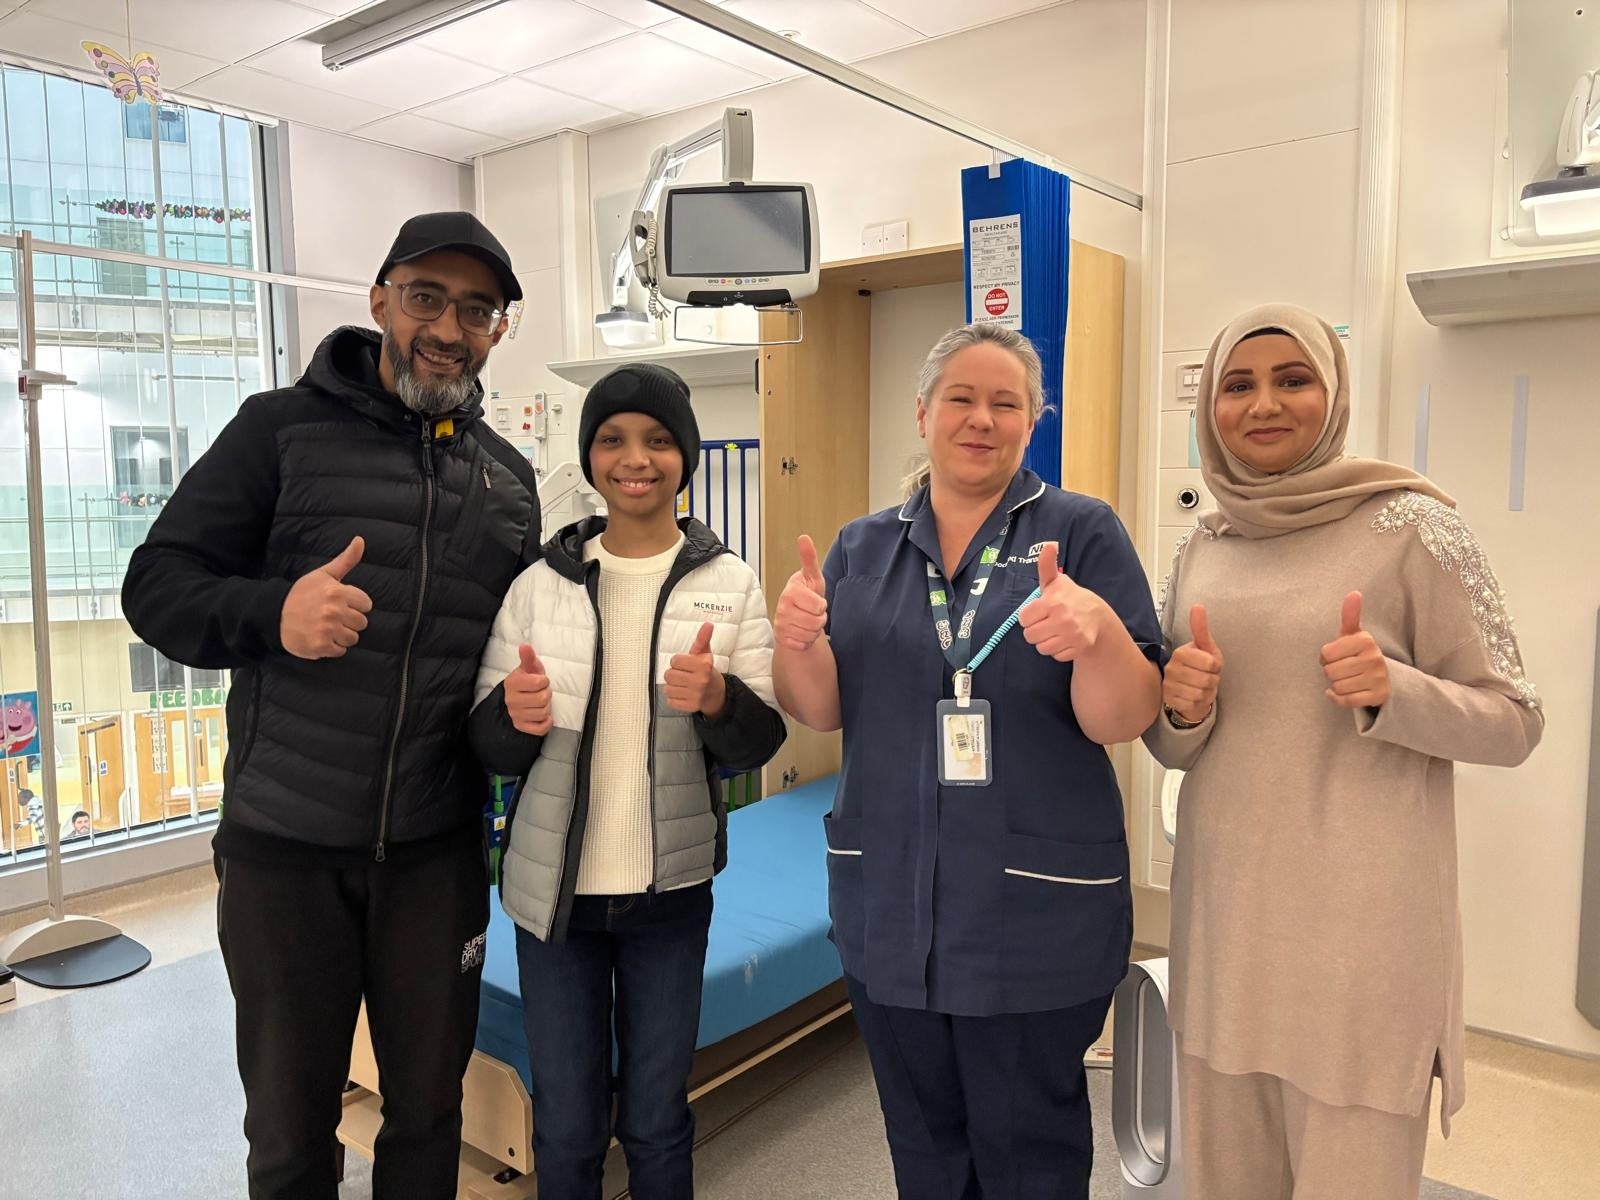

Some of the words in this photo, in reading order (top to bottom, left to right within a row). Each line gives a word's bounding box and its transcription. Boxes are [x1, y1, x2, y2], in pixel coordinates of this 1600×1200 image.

[972, 221, 1019, 233] BEHRENS
[694, 601, 733, 613] MCKENZIE
[461, 946, 478, 964] DRY
